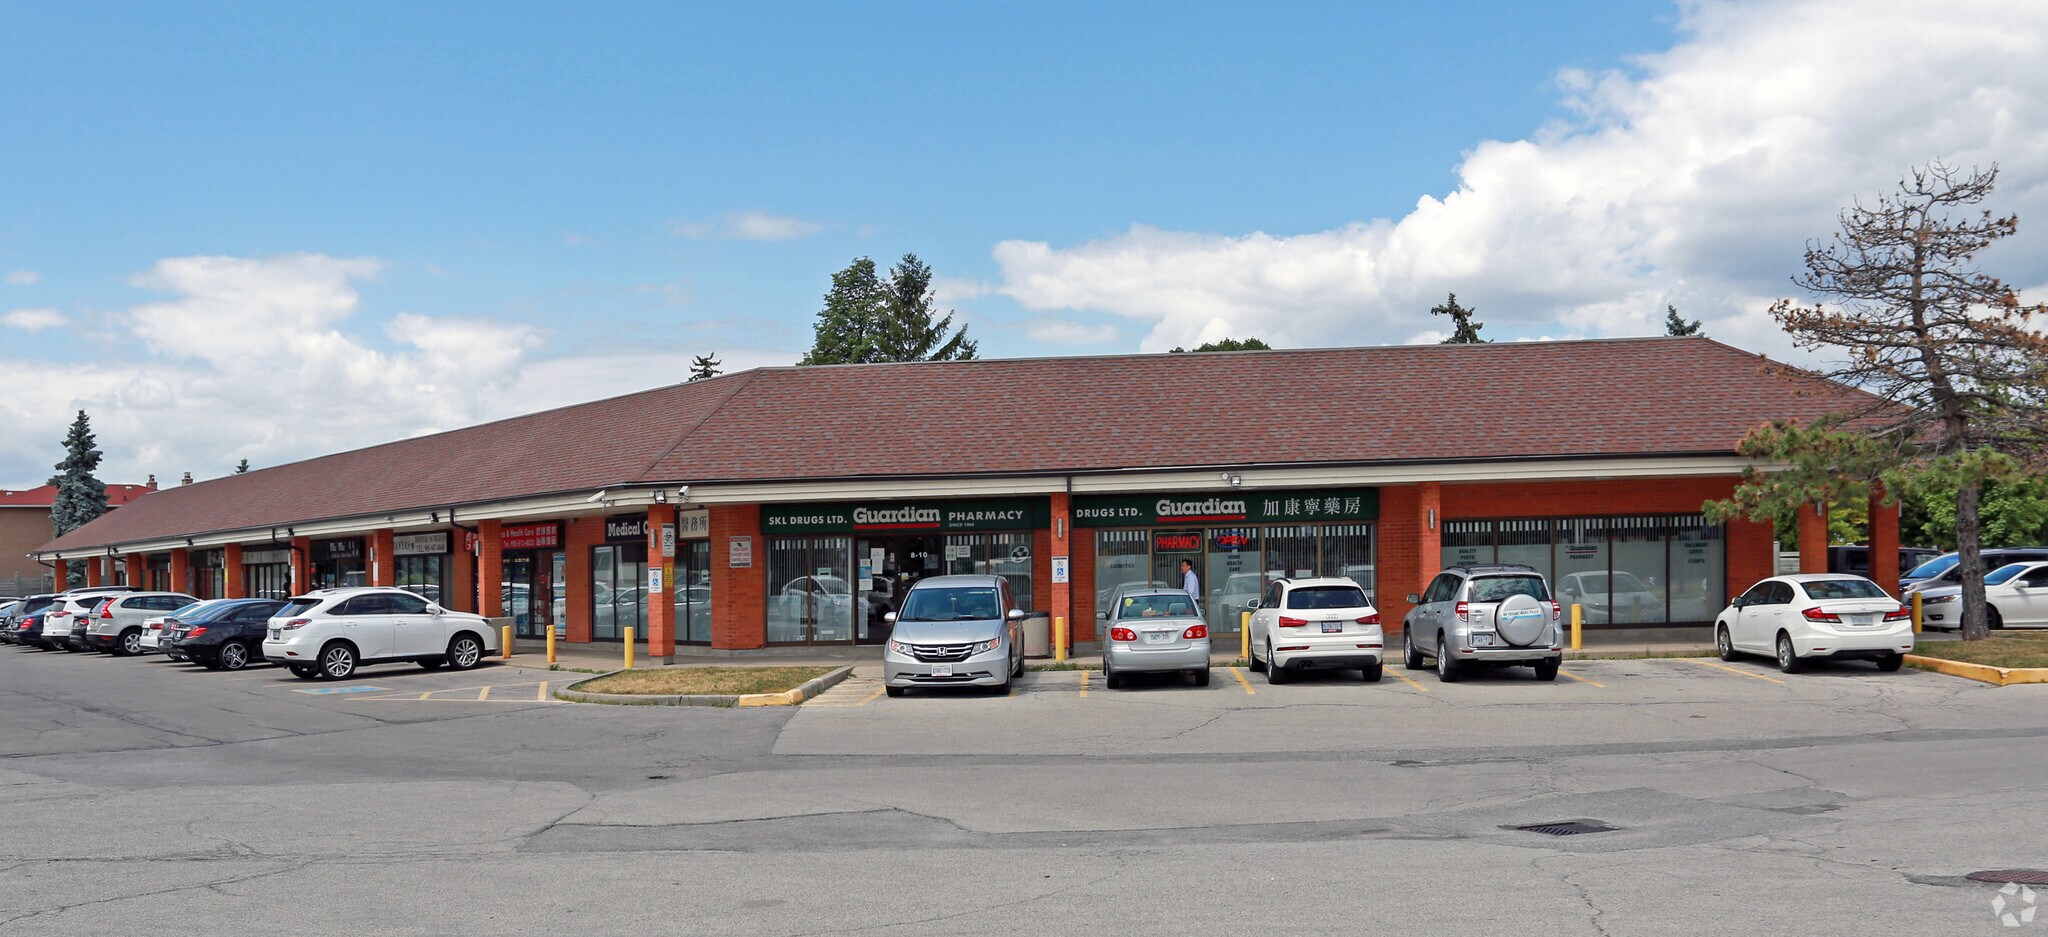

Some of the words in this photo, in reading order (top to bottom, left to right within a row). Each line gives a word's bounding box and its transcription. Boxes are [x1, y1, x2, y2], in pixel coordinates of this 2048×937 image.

[1076, 508, 1115, 518] DRUGS
[1119, 507, 1143, 517] LTD.
[1156, 498, 1246, 516] Guardian
[1263, 496, 1361, 517] 加康寧藥房
[768, 516, 787, 525] SKL
[790, 515, 824, 524] DRUGS
[827, 515, 848, 524] LTD.
[853, 506, 941, 523] Guardian
[948, 510, 1023, 521] PHARMACY
[607, 521, 640, 537] Medical
[681, 515, 707, 532] 醫務所
[1156, 536, 1200, 549] PHARMACY
[1217, 535, 1248, 545] OPEN
[910, 551, 928, 559] 8-10
